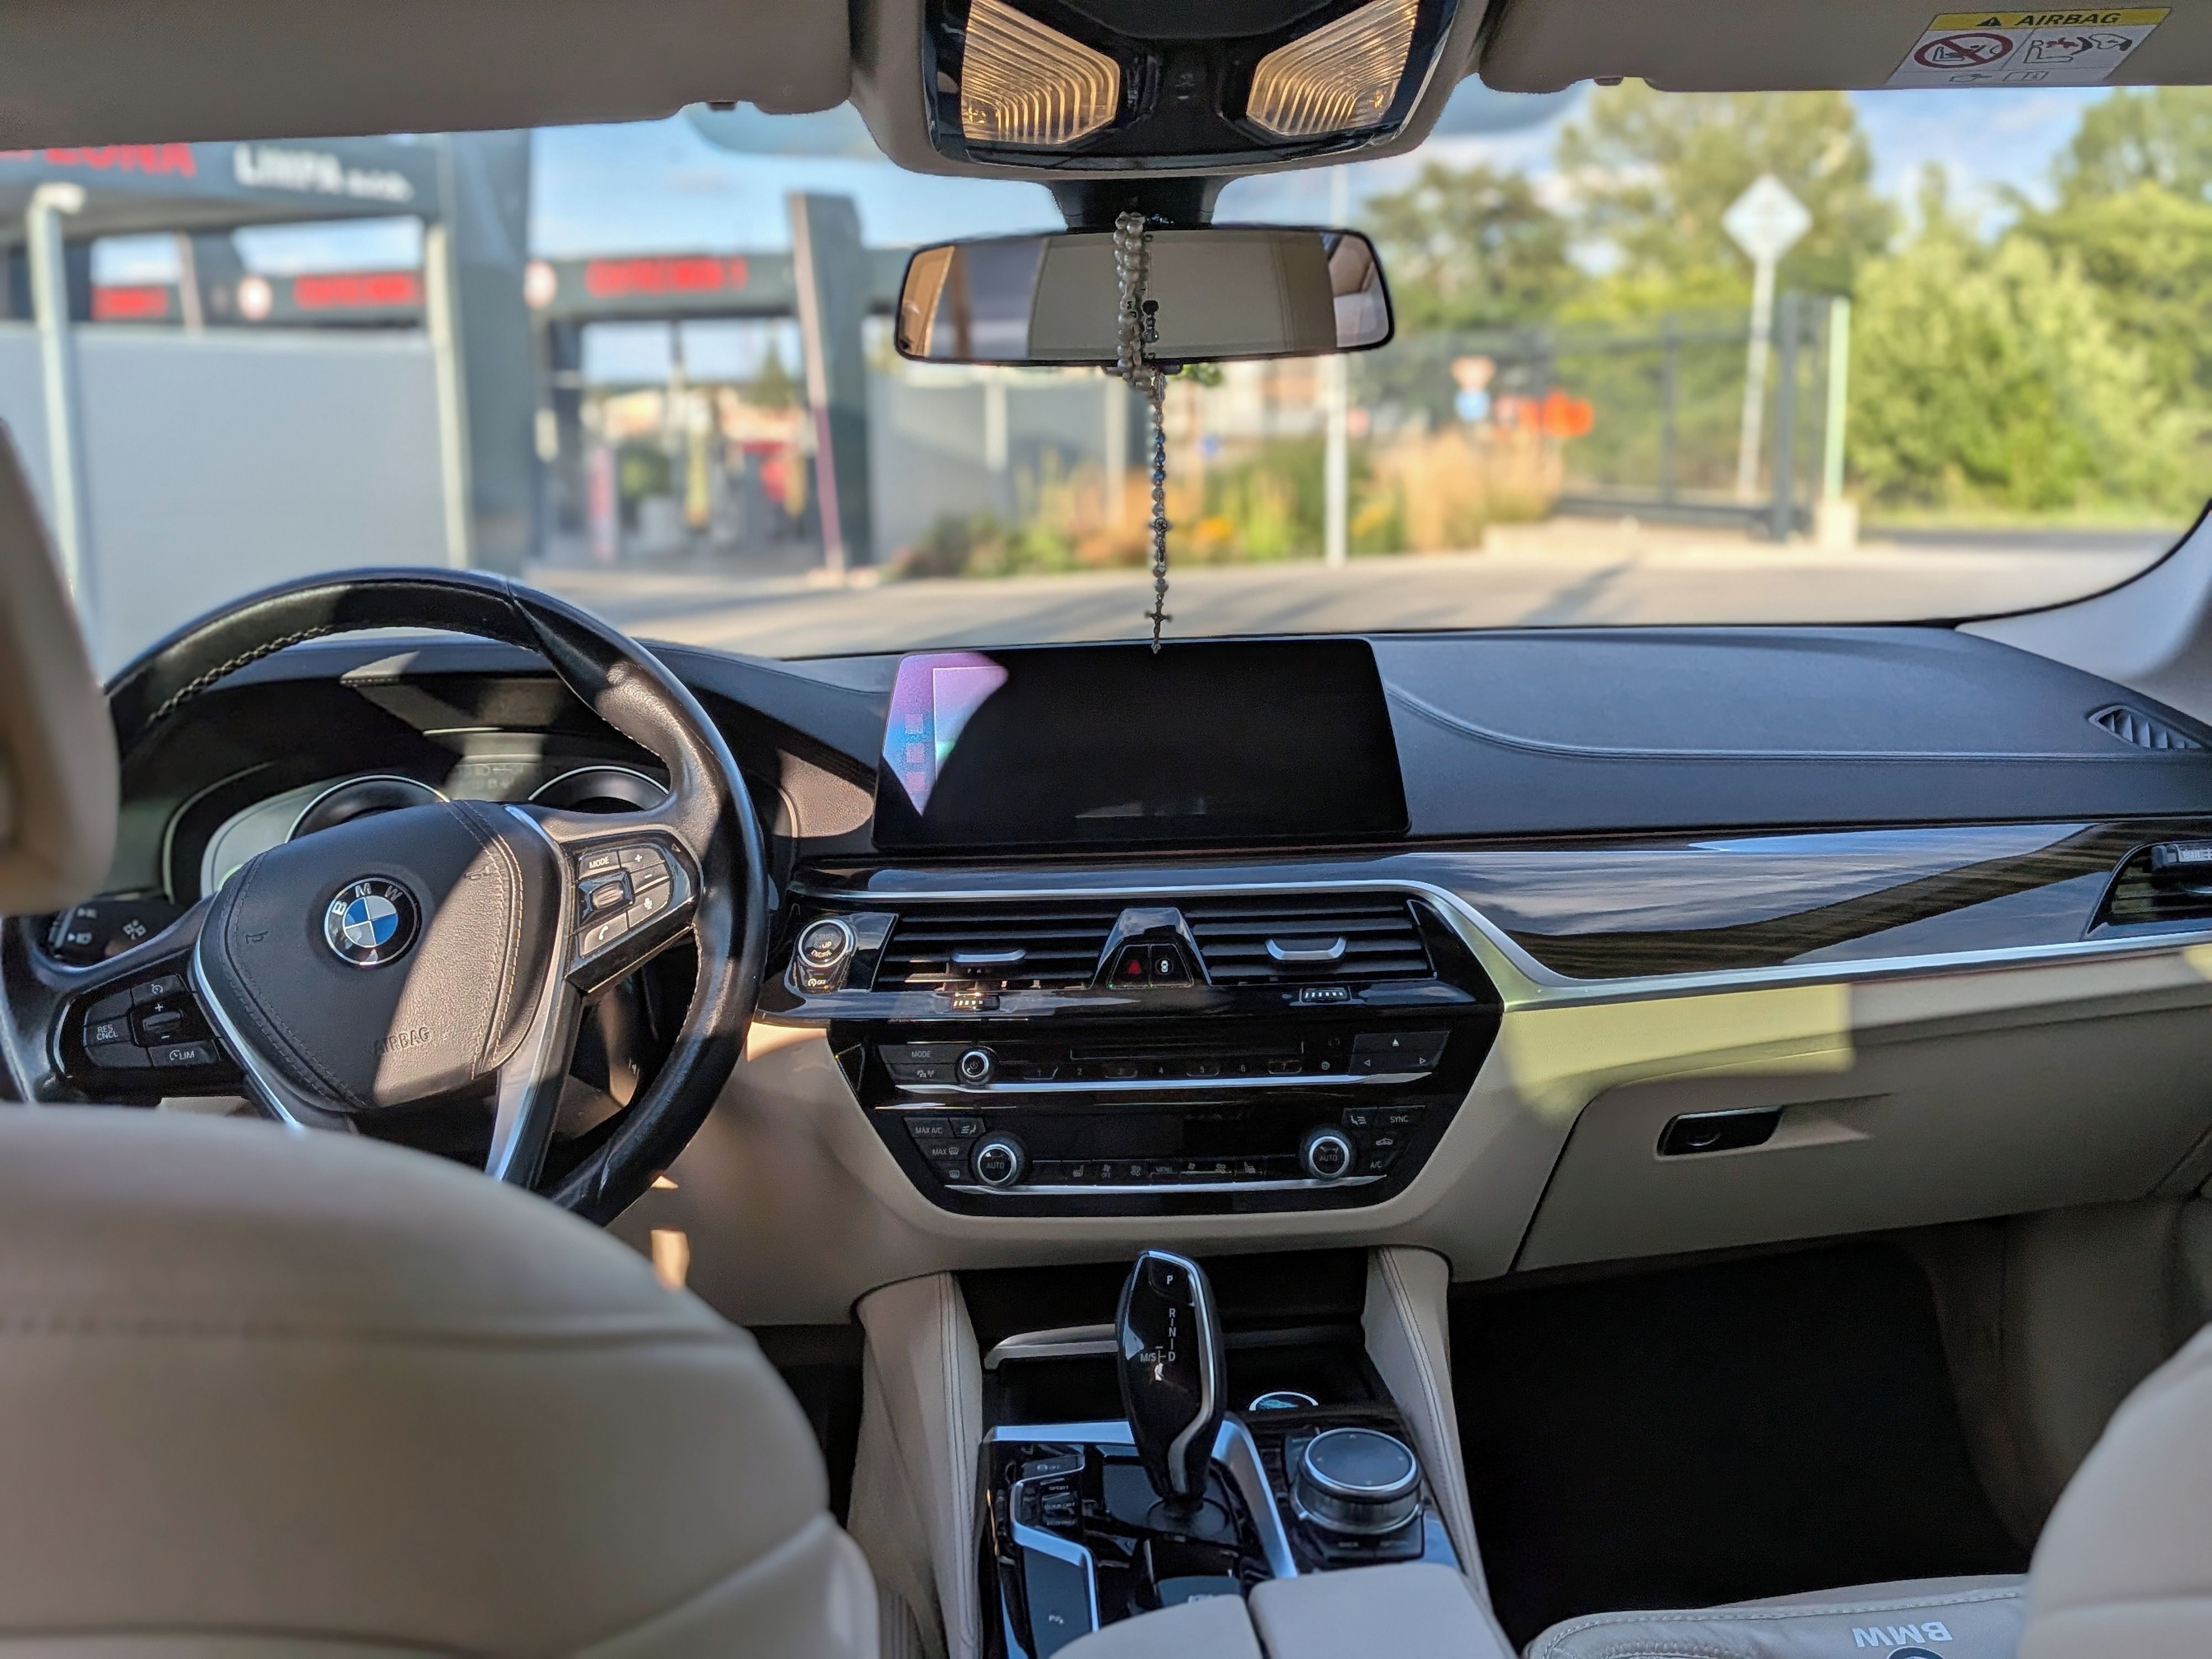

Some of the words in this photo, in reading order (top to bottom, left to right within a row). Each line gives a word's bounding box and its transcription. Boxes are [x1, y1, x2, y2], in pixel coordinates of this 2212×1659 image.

[2015, 13, 2121, 26] AIRBAG
[589, 856, 609, 869] MODE
[331, 883, 403, 916] BMW
[97, 1024, 114, 1033] RES
[96, 1030, 118, 1041] CNCL
[179, 1050, 195, 1061] LIM
[1166, 1275, 1173, 1285] P
[1169, 1308, 1176, 1318] R
[1168, 1327, 1176, 1337] N
[1140, 1353, 1156, 1362] M/S
[1168, 1352, 1176, 1362] D
[1852, 1621, 1953, 1648] BMW
